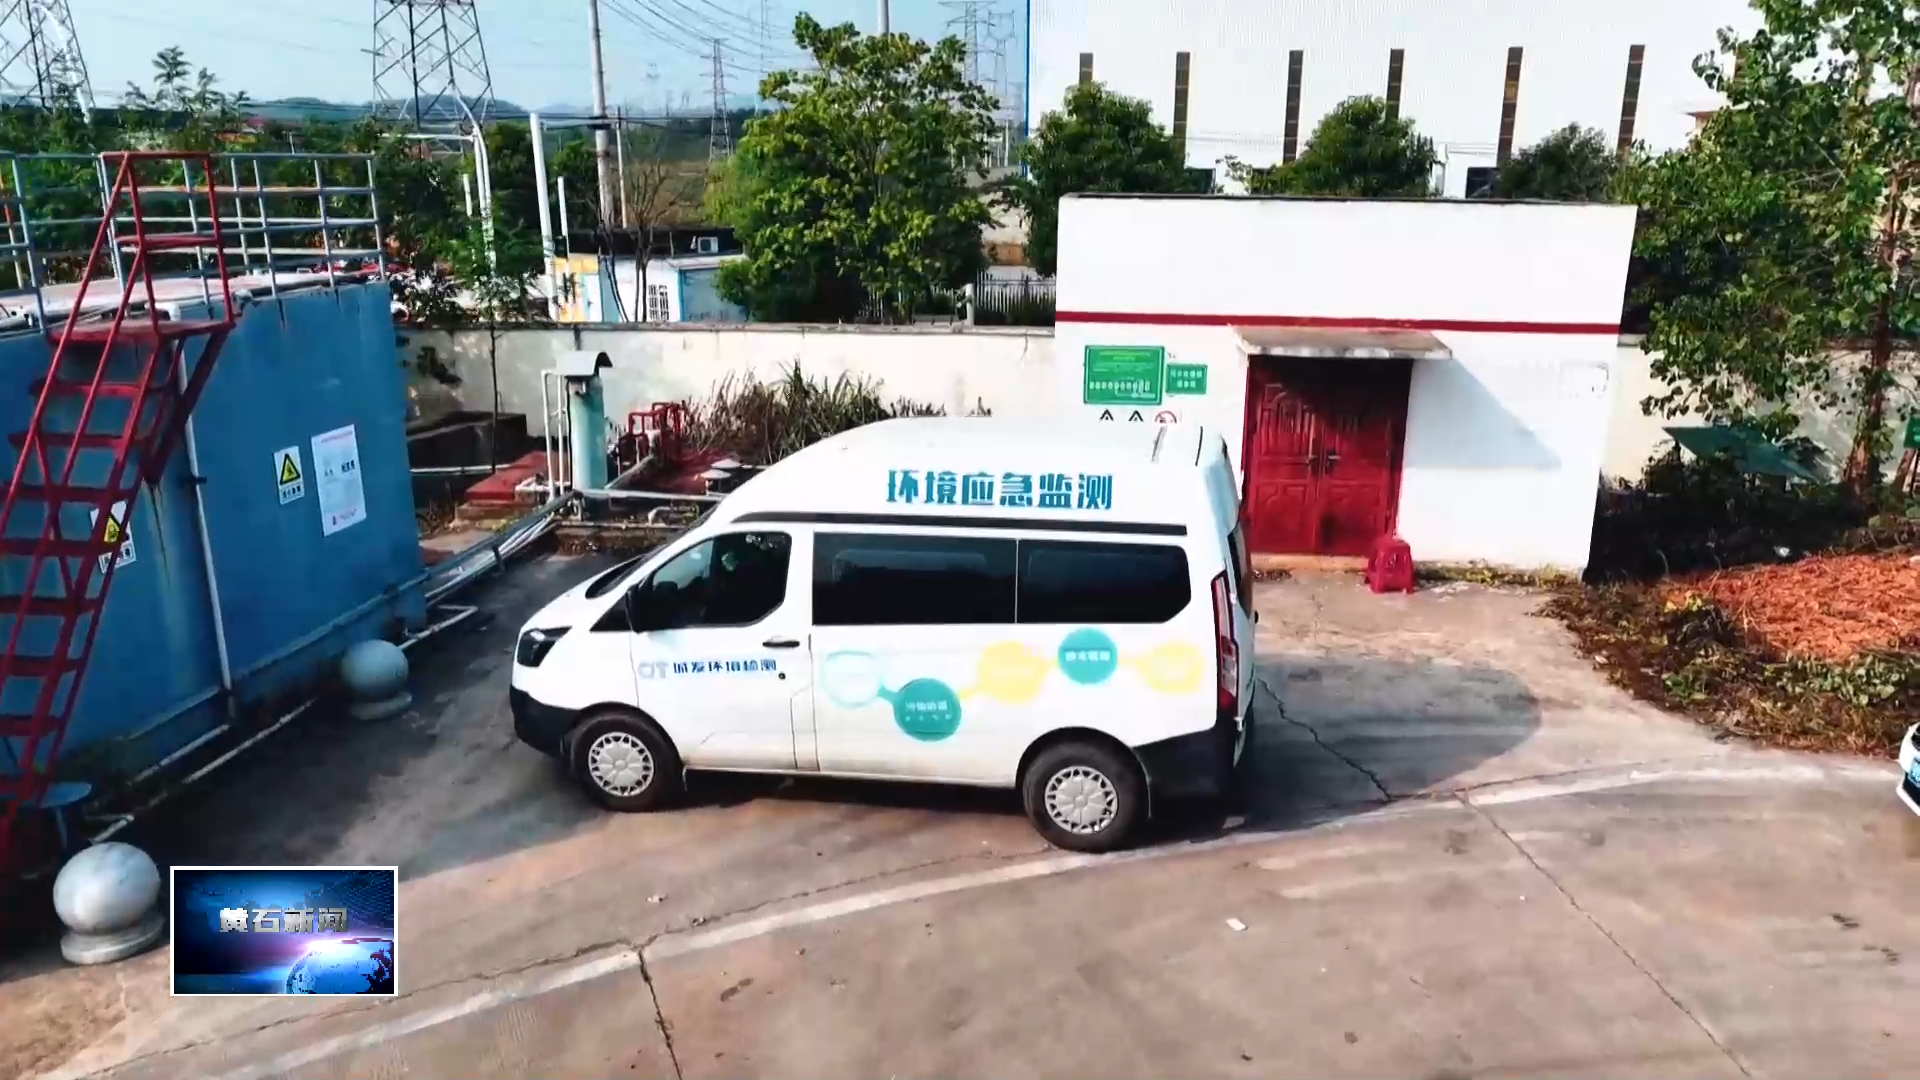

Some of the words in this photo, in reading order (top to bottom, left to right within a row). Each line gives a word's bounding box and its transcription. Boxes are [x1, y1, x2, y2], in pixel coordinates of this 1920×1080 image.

[886, 469, 1113, 509] 环境应急监测
